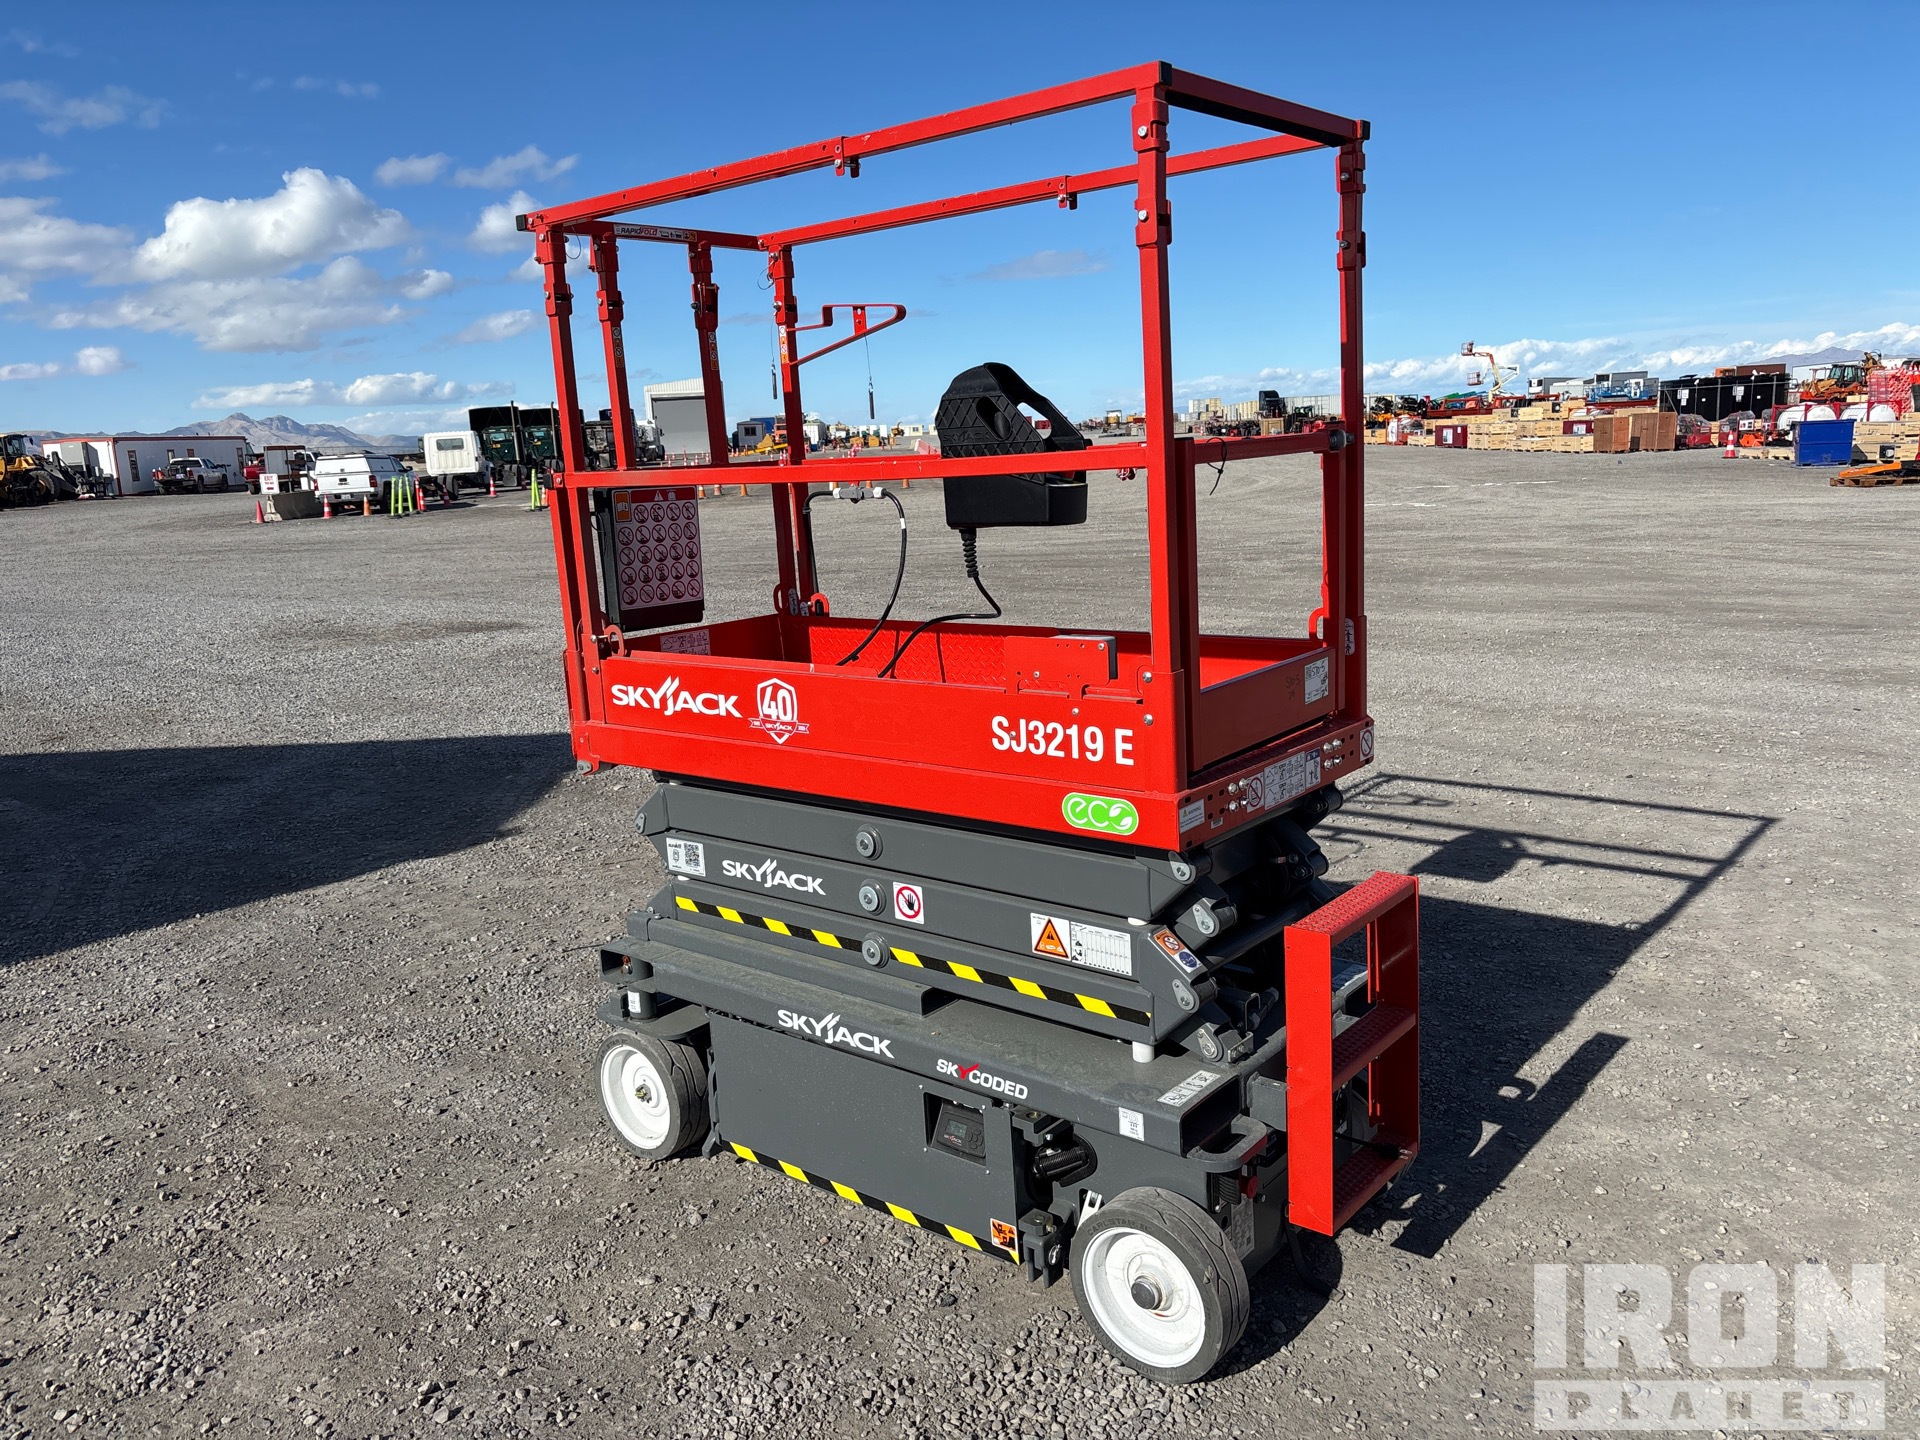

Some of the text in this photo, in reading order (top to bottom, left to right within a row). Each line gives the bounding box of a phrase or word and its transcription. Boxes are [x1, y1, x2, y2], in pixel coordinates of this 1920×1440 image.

[611, 675, 743, 718] SKYJACK
[762, 685, 793, 721] 40
[765, 722, 793, 731] SKYJACK
[991, 715, 1135, 766] SJ3219 E
[1067, 797, 1133, 831] eco
[721, 858, 827, 896] SKYJACK
[777, 1009, 895, 1059] SKYJACK
[936, 1058, 1028, 1099] SKYCODED
